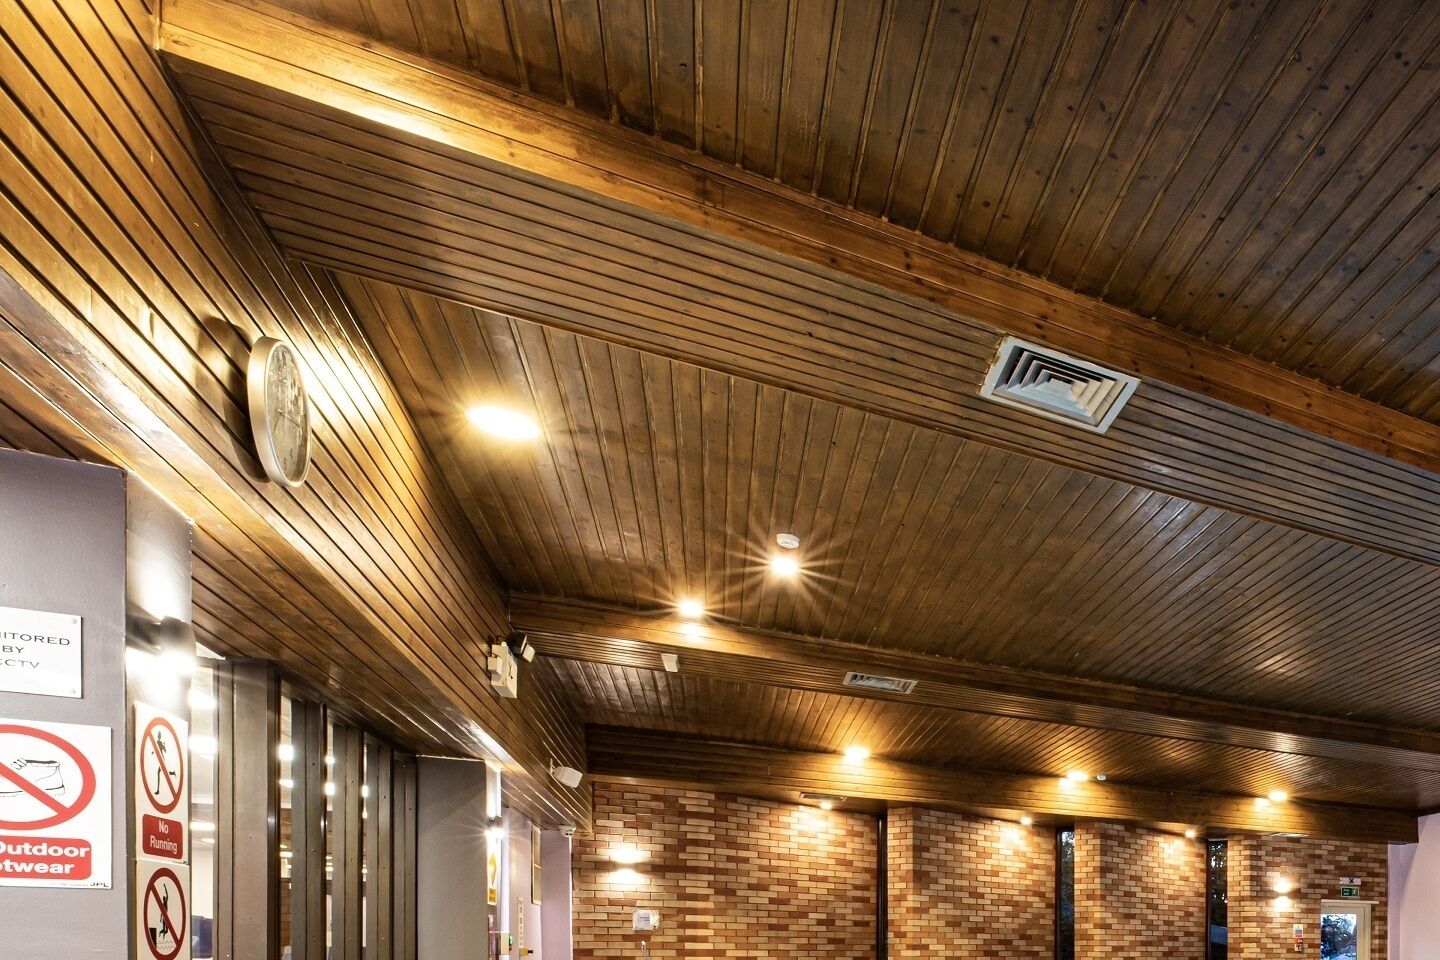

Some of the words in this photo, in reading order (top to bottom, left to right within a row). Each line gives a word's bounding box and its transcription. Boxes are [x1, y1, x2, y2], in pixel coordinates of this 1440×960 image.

[0, 632, 70, 646] ITORED
[2, 645, 24, 653] BY
[0, 659, 39, 669] CTV
[158, 820, 169, 834] No
[150, 835, 178, 854] Running
[0, 859, 75, 874] twear
